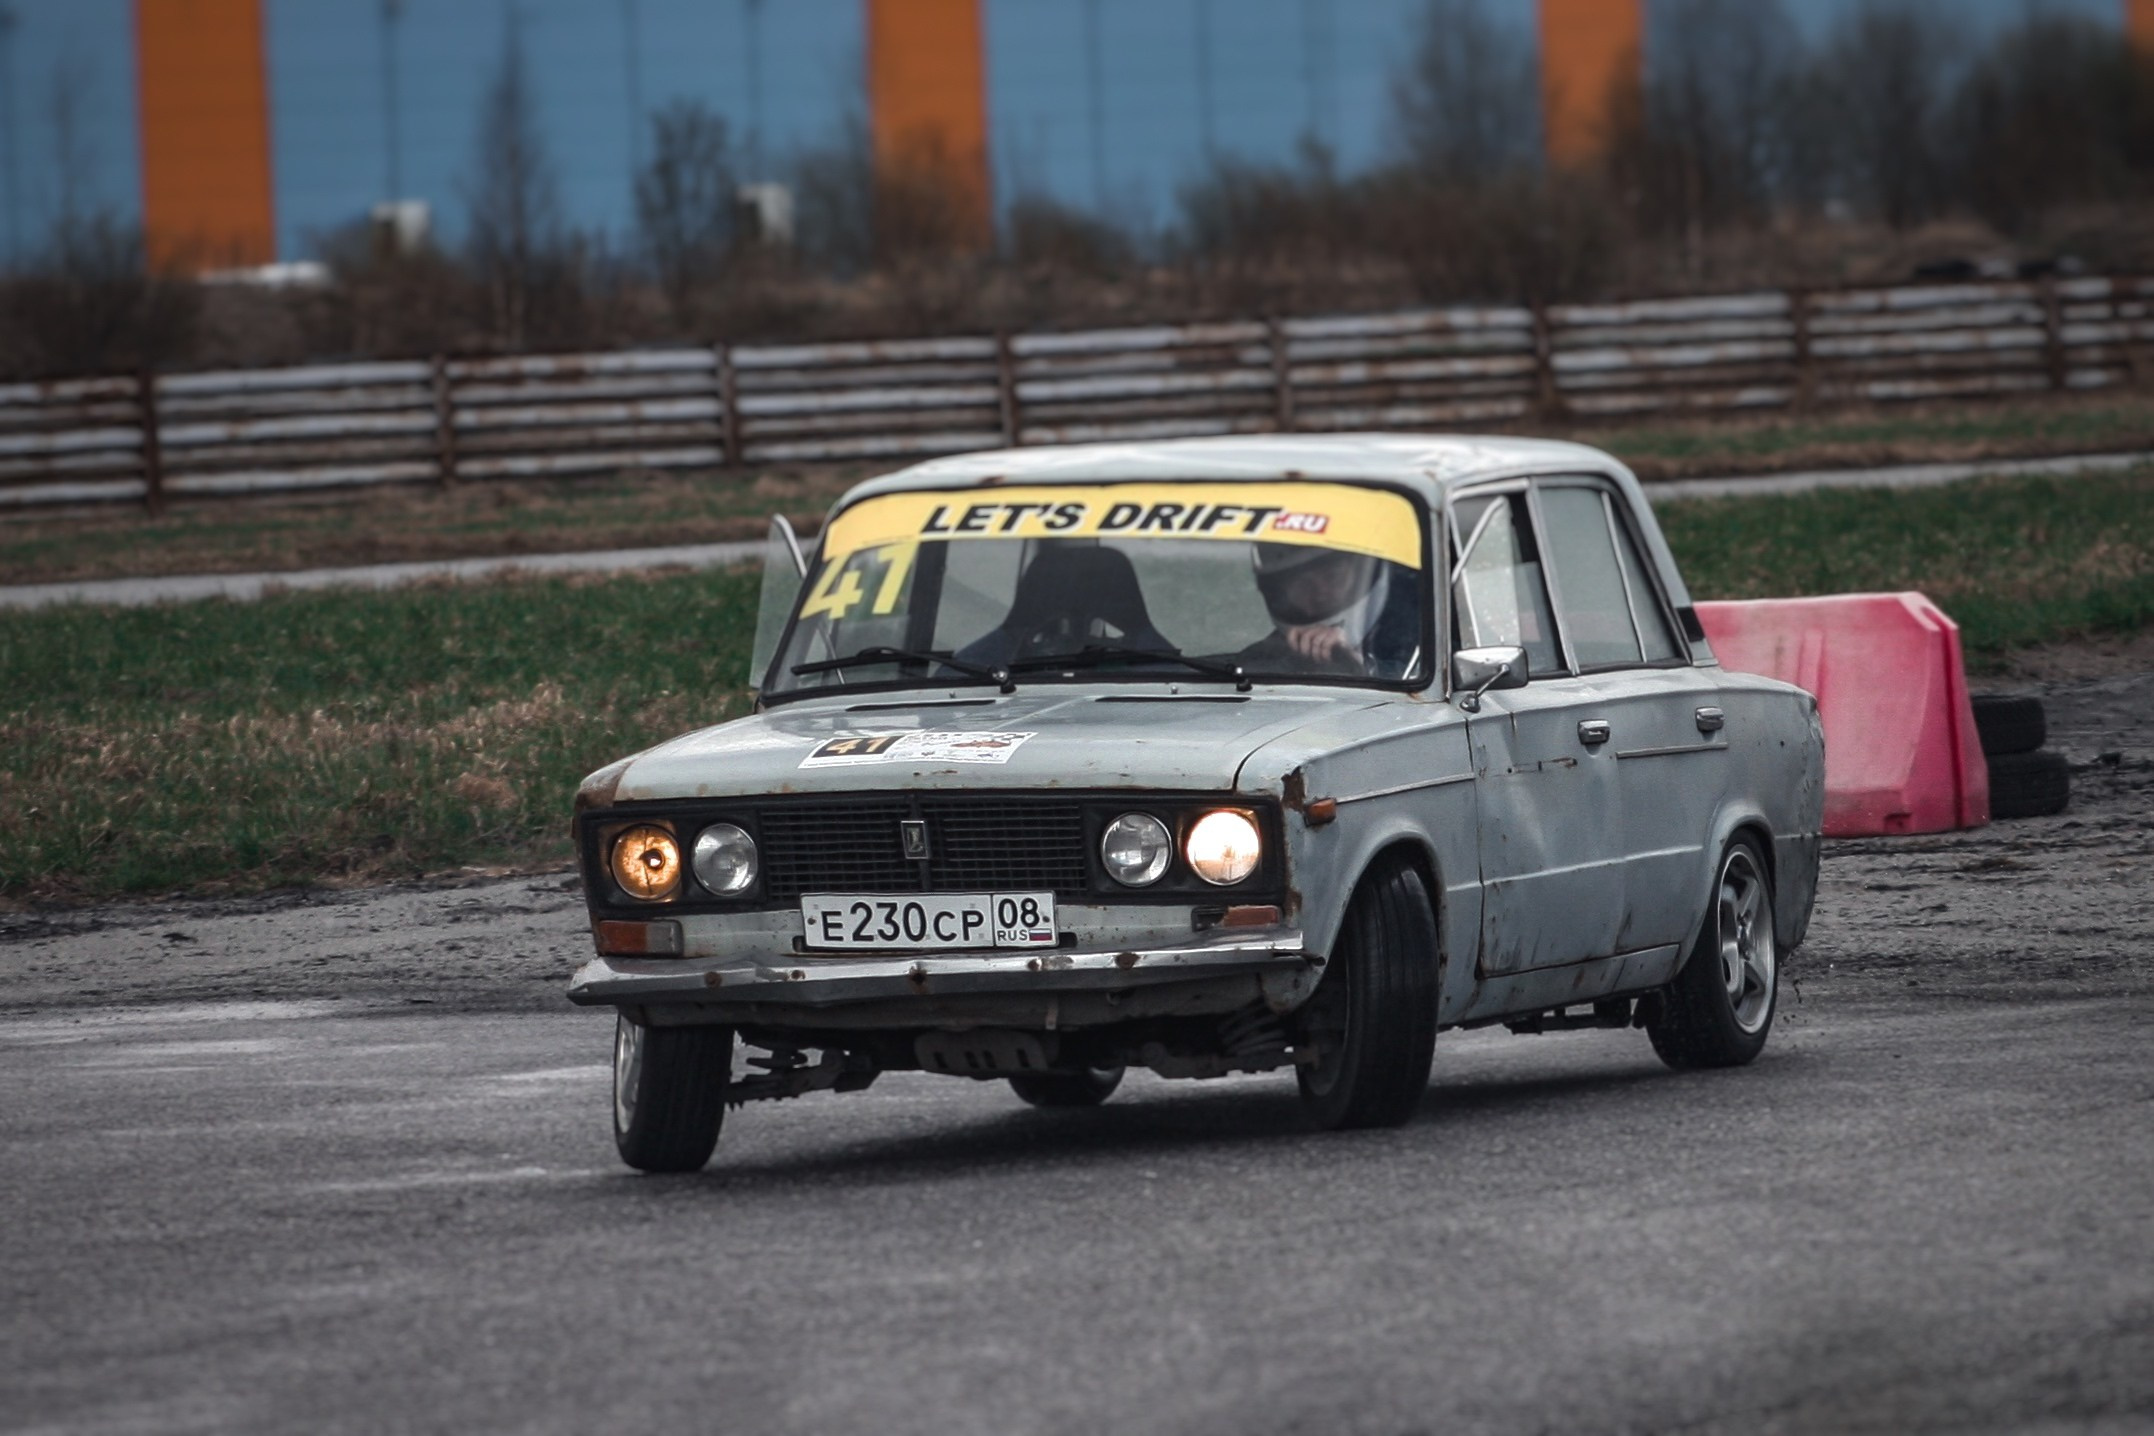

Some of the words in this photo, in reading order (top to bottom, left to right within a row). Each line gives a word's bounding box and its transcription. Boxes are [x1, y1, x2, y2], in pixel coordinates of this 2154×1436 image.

[920, 503, 1087, 535] LET'S
[799, 541, 921, 620] 41
[825, 736, 891, 755] 41
[998, 898, 1040, 929] 08
[997, 930, 1028, 941] RUS
